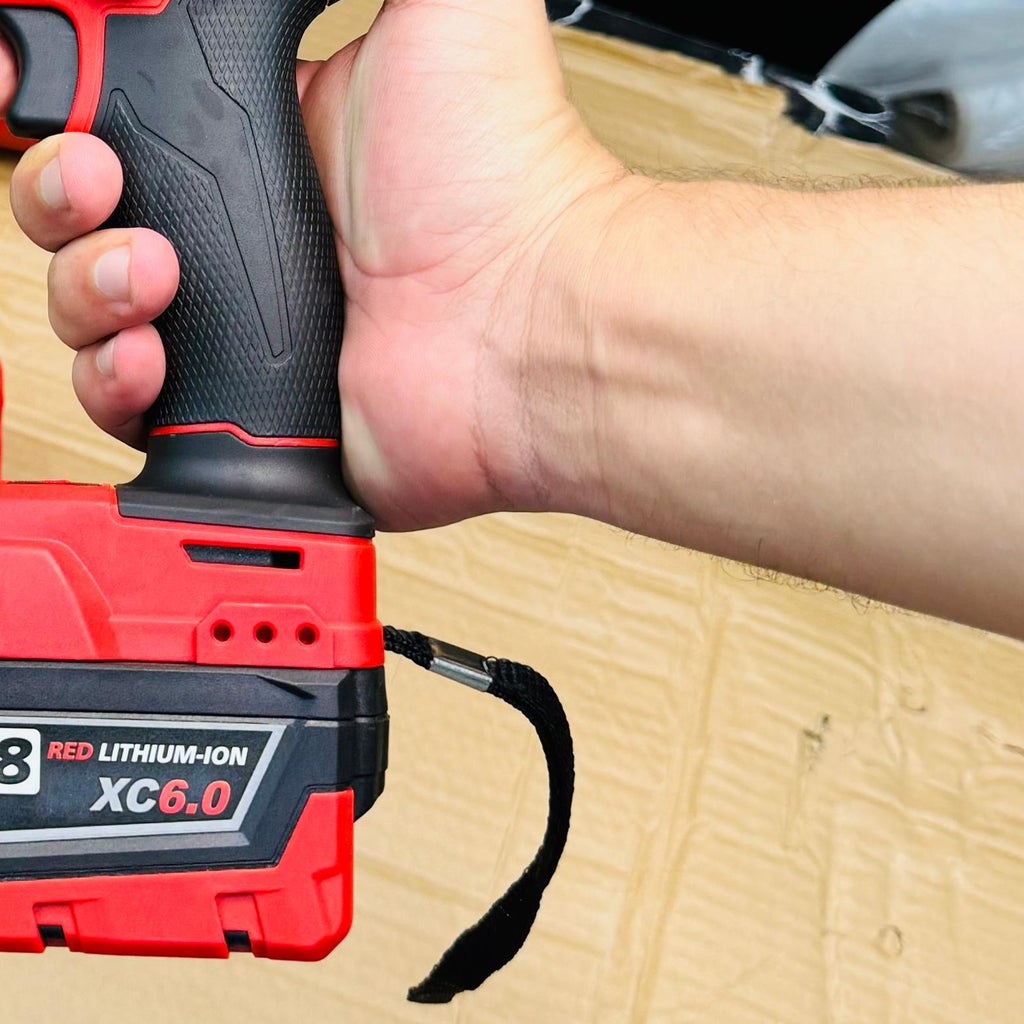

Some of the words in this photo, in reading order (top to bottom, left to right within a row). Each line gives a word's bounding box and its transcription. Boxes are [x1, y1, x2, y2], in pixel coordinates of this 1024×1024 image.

[47, 741, 93, 761] RED
[98, 742, 248, 766] LITHIUM-ION
[89, 777, 231, 815] XC6.0
